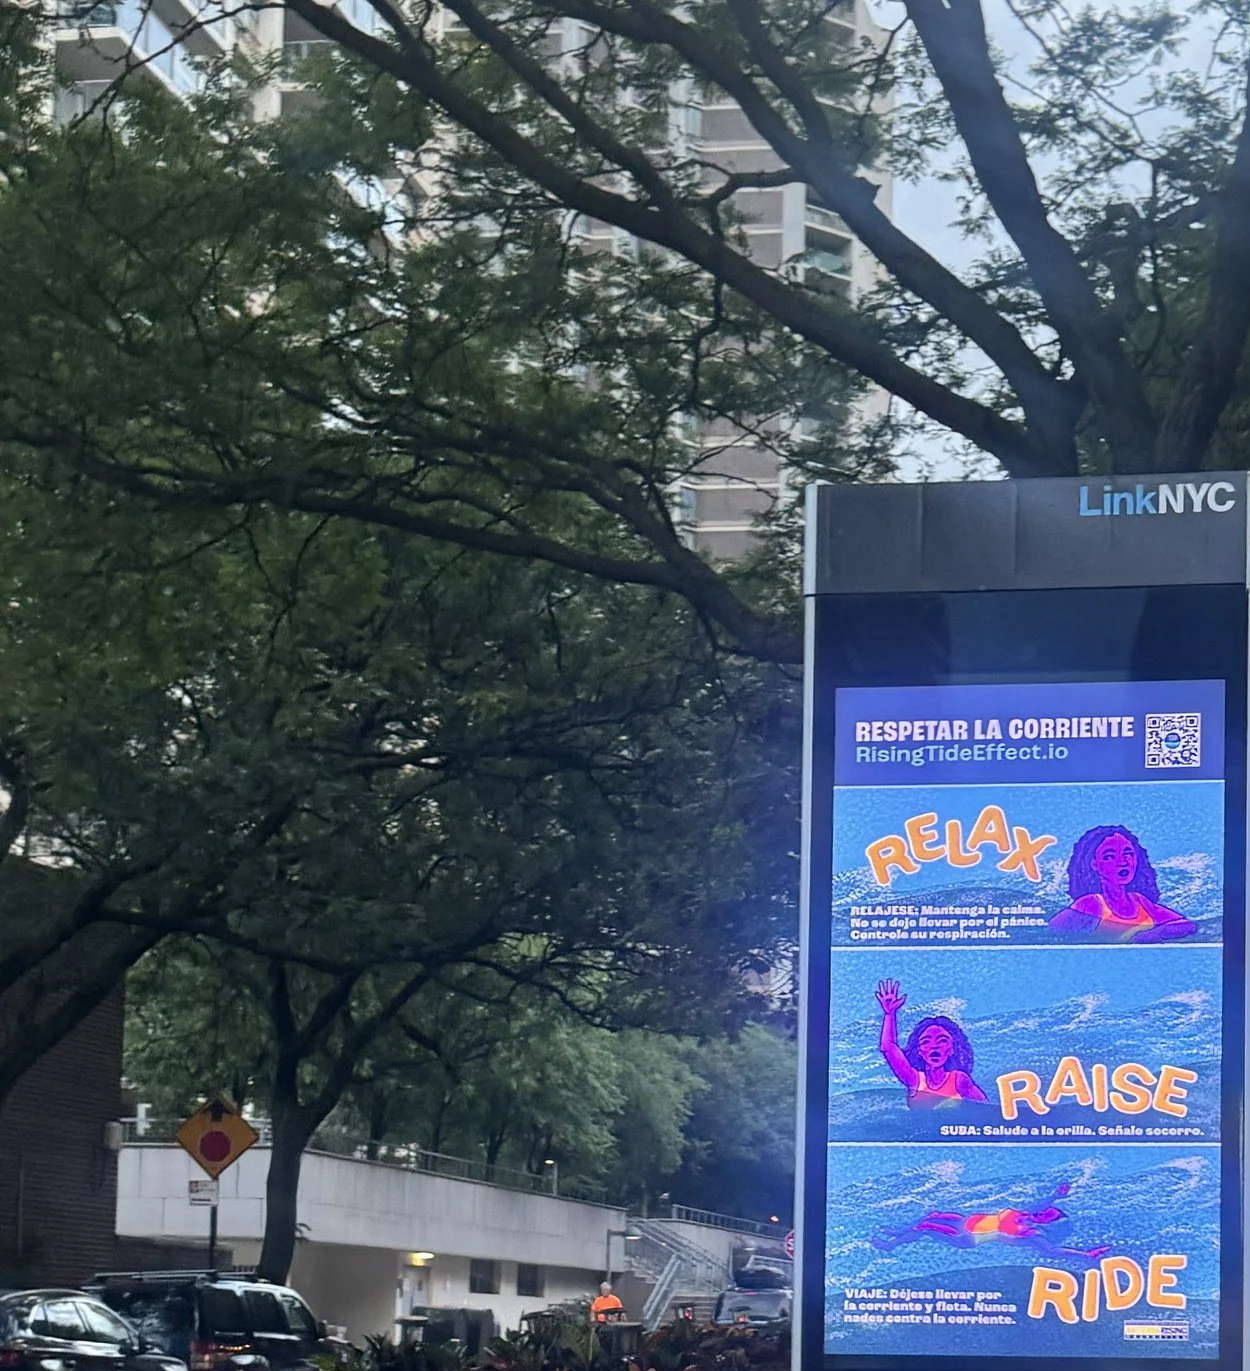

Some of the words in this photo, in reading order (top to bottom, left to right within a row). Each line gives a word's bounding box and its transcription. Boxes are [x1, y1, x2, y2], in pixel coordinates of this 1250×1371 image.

[1079, 481, 1236, 516] LinkNYC
[855, 719, 968, 742] RESPETAR
[974, 719, 1003, 740] LA
[1008, 716, 1135, 739] CORRIENTE
[855, 743, 1069, 766] RisingTideEffect.io
[866, 804, 1058, 885] RELAX
[920, 905, 986, 917] Mantenga
[987, 904, 1001, 915] la
[1002, 904, 1046, 915] calma.
[850, 918, 869, 928] No
[918, 917, 958, 928] llevar
[959, 918, 985, 930] por
[1000, 916, 1049, 929] pánico.
[850, 929, 909, 940] Controle
[910, 930, 927, 940] su
[929, 928, 1011, 942] respiración.
[996, 1056, 1198, 1120] RAISE
[940, 1125, 981, 1136] SUBA:
[1030, 1127, 1040, 1136] a
[1041, 1125, 1054, 1136] la
[1055, 1125, 1096, 1136] orilla.
[1098, 1124, 1143, 1136] Señale
[1145, 1126, 1205, 1136] socorro.
[844, 1288, 888, 1299] VIAJE:
[935, 1288, 975, 1299] llevar
[976, 1290, 1003, 1302] por
[1027, 1255, 1187, 1323] RIDE
[843, 1300, 858, 1311] la
[858, 1301, 923, 1311] corriente
[924, 1303, 935, 1314] y
[973, 1301, 1017, 1312] Nunca
[885, 1313, 932, 1324] contra
[933, 1313, 947, 1324] la
[947, 1313, 1017, 1325] corriente.
